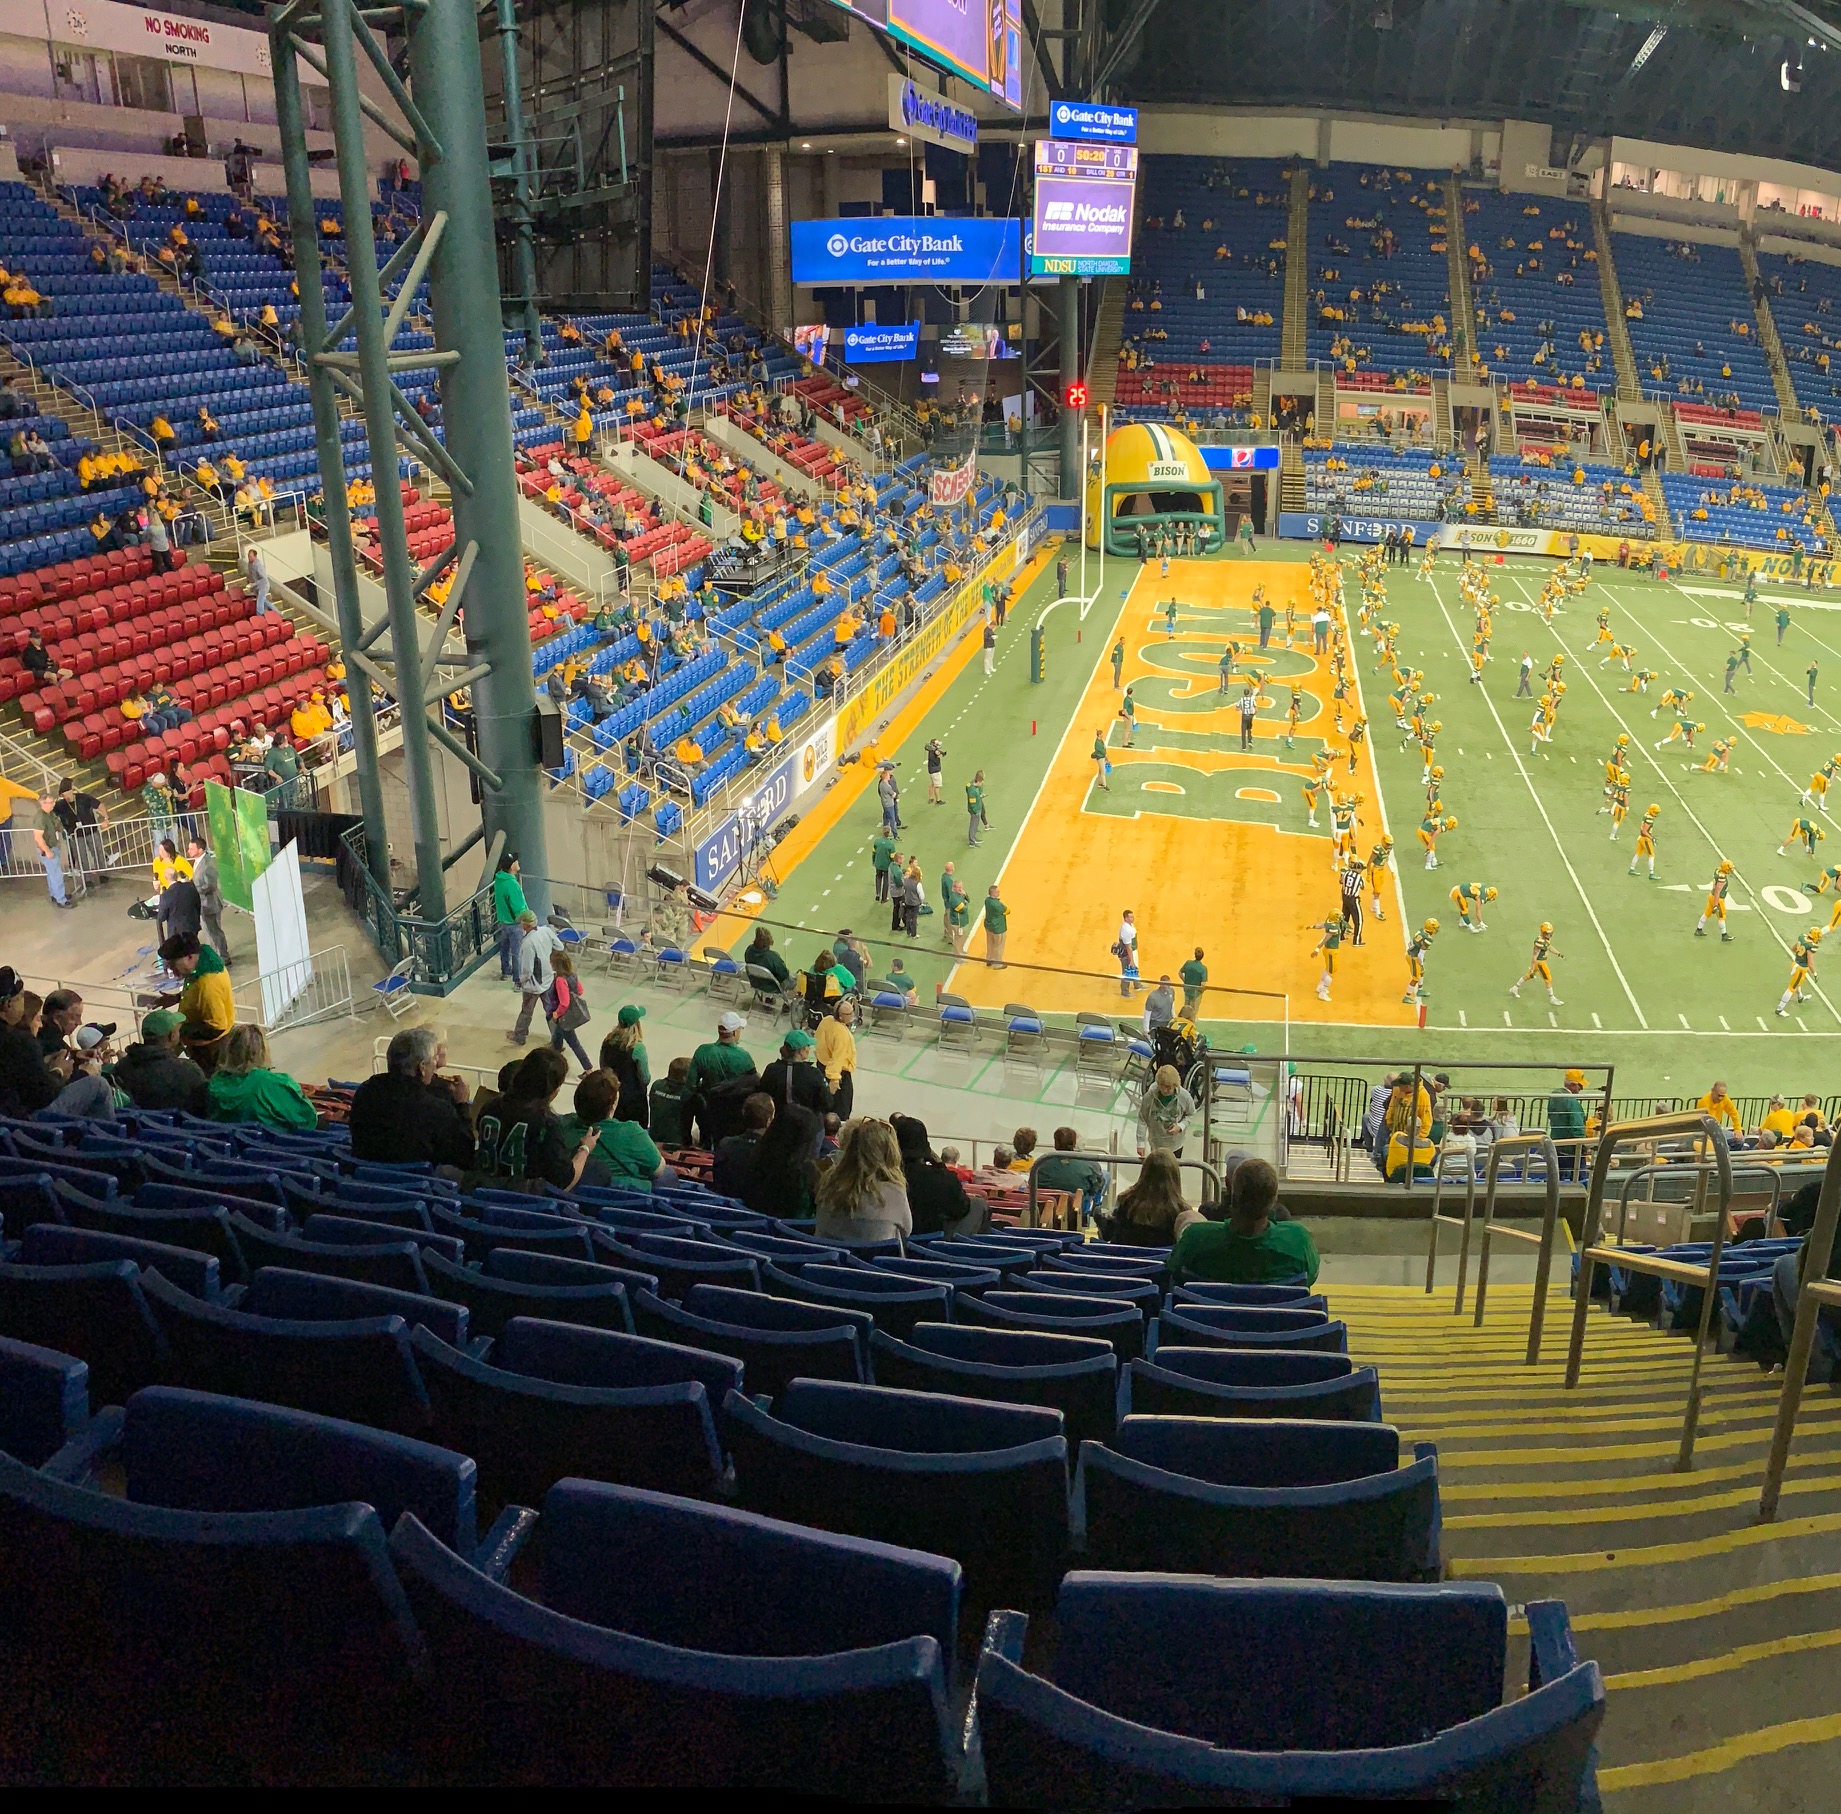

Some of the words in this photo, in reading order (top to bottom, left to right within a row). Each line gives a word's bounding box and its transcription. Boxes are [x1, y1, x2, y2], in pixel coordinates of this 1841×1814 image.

[144, 16, 162, 34] NO
[164, 19, 210, 44] SMOKING
[165, 43, 198, 59] NORTH
[1071, 109, 1094, 123] Gate
[1094, 111, 1114, 128] City
[1113, 113, 1134, 127] Bank
[1057, 150, 1065, 162] 0
[1076, 150, 1105, 162] 50:20
[1113, 155, 1121, 167] 0
[1541, 170, 1564, 178] EAST
[1075, 203, 1127, 223] Nodak
[1042, 221, 1087, 232] Insurance
[1087, 223, 1125, 235] Company
[850, 236, 886, 254] Gate
[887, 235, 921, 256] City
[921, 235, 963, 253] Bank
[867, 258, 879, 266] For
[886, 258, 907, 266] Better
[908, 258, 922, 267] Way
[923, 258, 931, 266] of
[1043, 259, 1077, 273] NDSU
[1077, 259, 1097, 267] NORTH
[858, 335, 877, 346] Gate
[876, 334, 894, 346] City
[893, 332, 915, 343] Bank
[1069, 388, 1086, 406] 25
[1153, 466, 1185, 477] BISON
[1306, 517, 1416, 540] SNFORD
[1455, 529, 1492, 543] BSON
[1510, 535, 1538, 546] 1660
[875, 670, 896, 712] THE
[897, 624, 945, 689] STRENGTH
[955, 590, 970, 627] THE
[1081, 600, 1335, 840] BISON
[816, 740, 829, 763] WILD
[1336, 810, 1352, 823] 17
[1696, 880, 1813, 916] 10
[478, 1115, 529, 1177] 84
